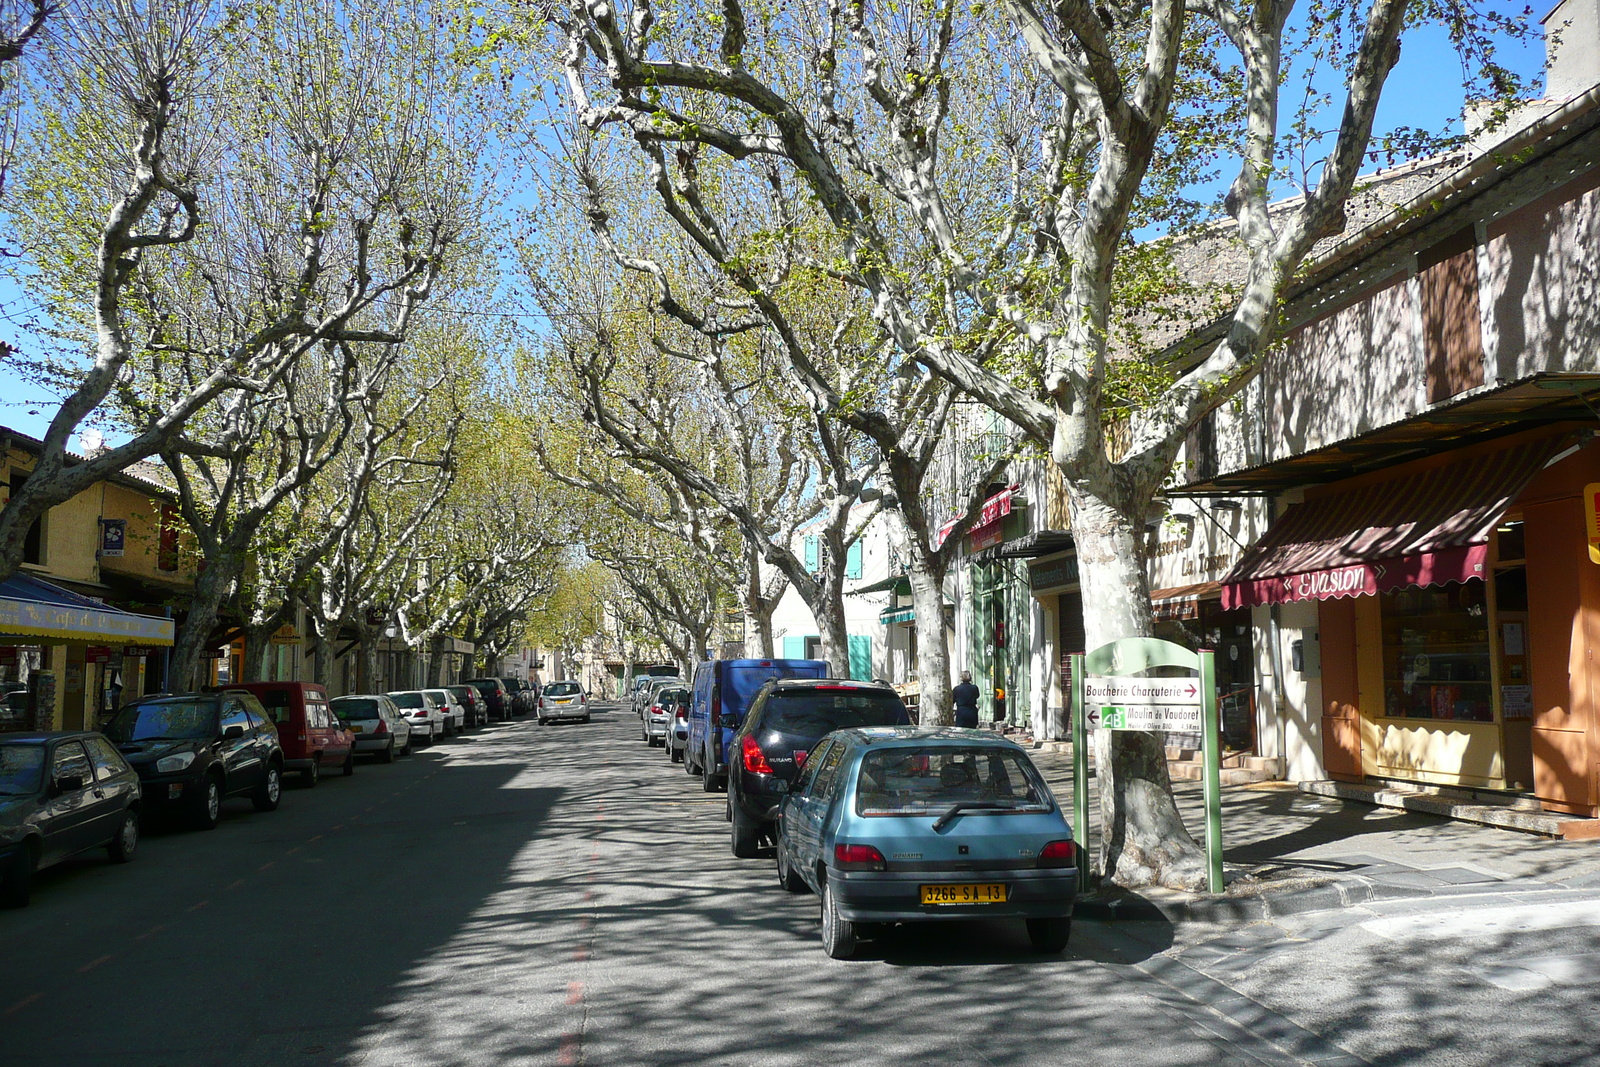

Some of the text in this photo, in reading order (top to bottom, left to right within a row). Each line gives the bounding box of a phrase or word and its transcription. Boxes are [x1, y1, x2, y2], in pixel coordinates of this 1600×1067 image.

[1298, 567, 1365, 597] Evasion
[46, 608, 75, 630] Café
[129, 647, 151, 656] Bar
[201, 650, 220, 658] Bar
[1086, 684, 1182, 697] Boucherie Charcuterie
[1102, 712, 1123, 728] AB
[1127, 708, 1199, 721] Moulin de Vaudoret
[926, 885, 1000, 902] 3266 SA 13
